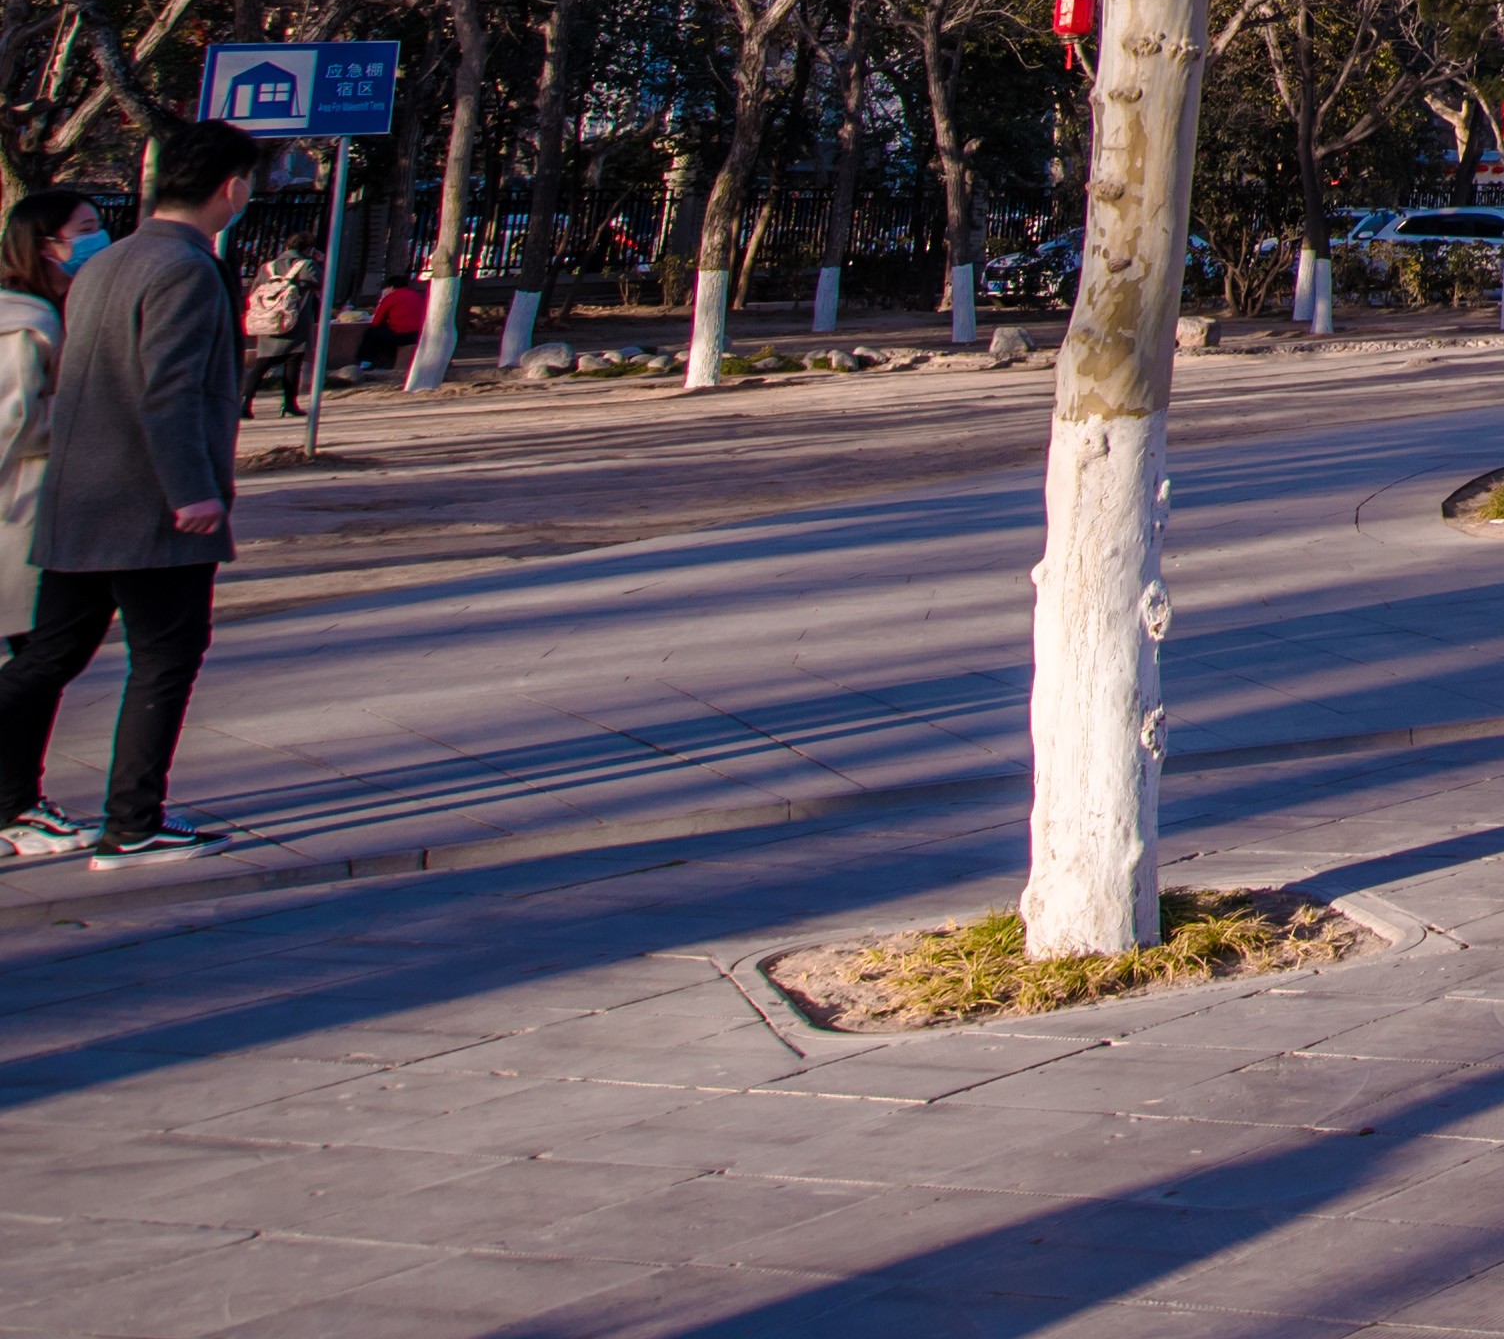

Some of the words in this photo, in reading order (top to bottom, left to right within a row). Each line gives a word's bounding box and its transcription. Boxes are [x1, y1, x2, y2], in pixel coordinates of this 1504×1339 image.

[325, 62, 384, 78] 应急棚
[336, 81, 374, 96] 宿区
